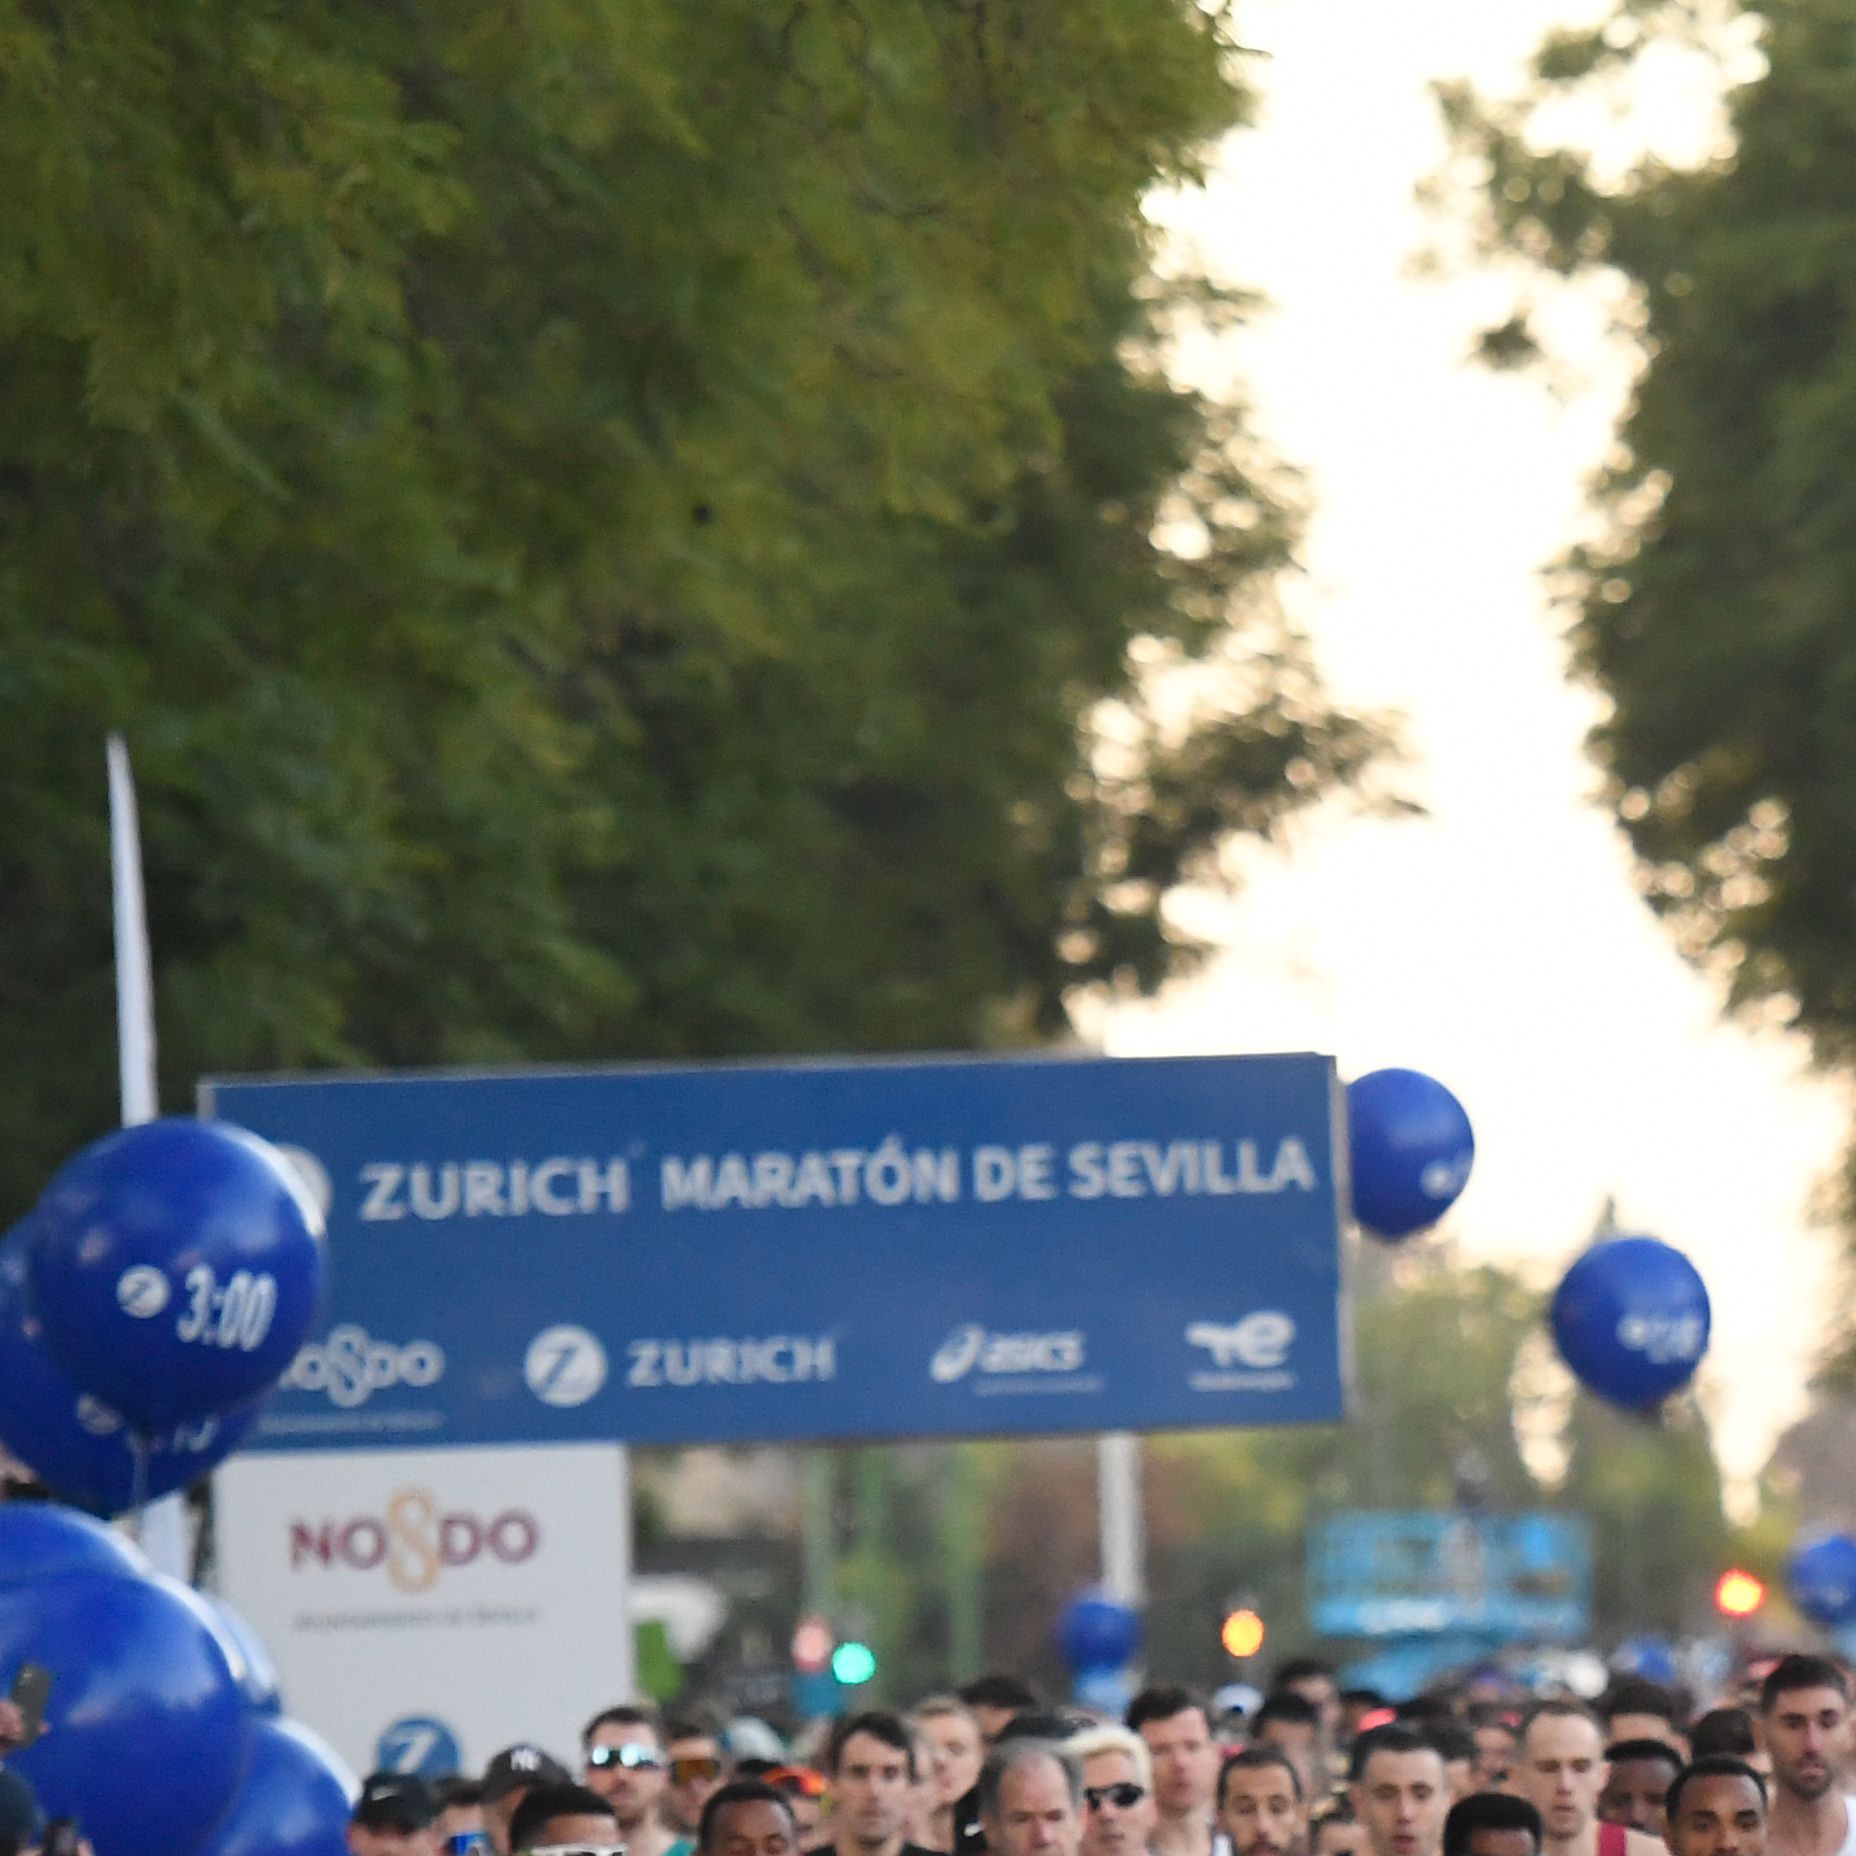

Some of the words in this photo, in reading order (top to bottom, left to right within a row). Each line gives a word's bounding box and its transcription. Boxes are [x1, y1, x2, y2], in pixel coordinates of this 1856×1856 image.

[359, 1156, 630, 1221] ZURICH
[661, 1134, 959, 1210] MARATÓN
[974, 1142, 1057, 1201] DE
[1069, 1136, 1317, 1198] SEVILLA
[176, 1262, 278, 1351] 3:00
[627, 1336, 837, 1388] ZURICH
